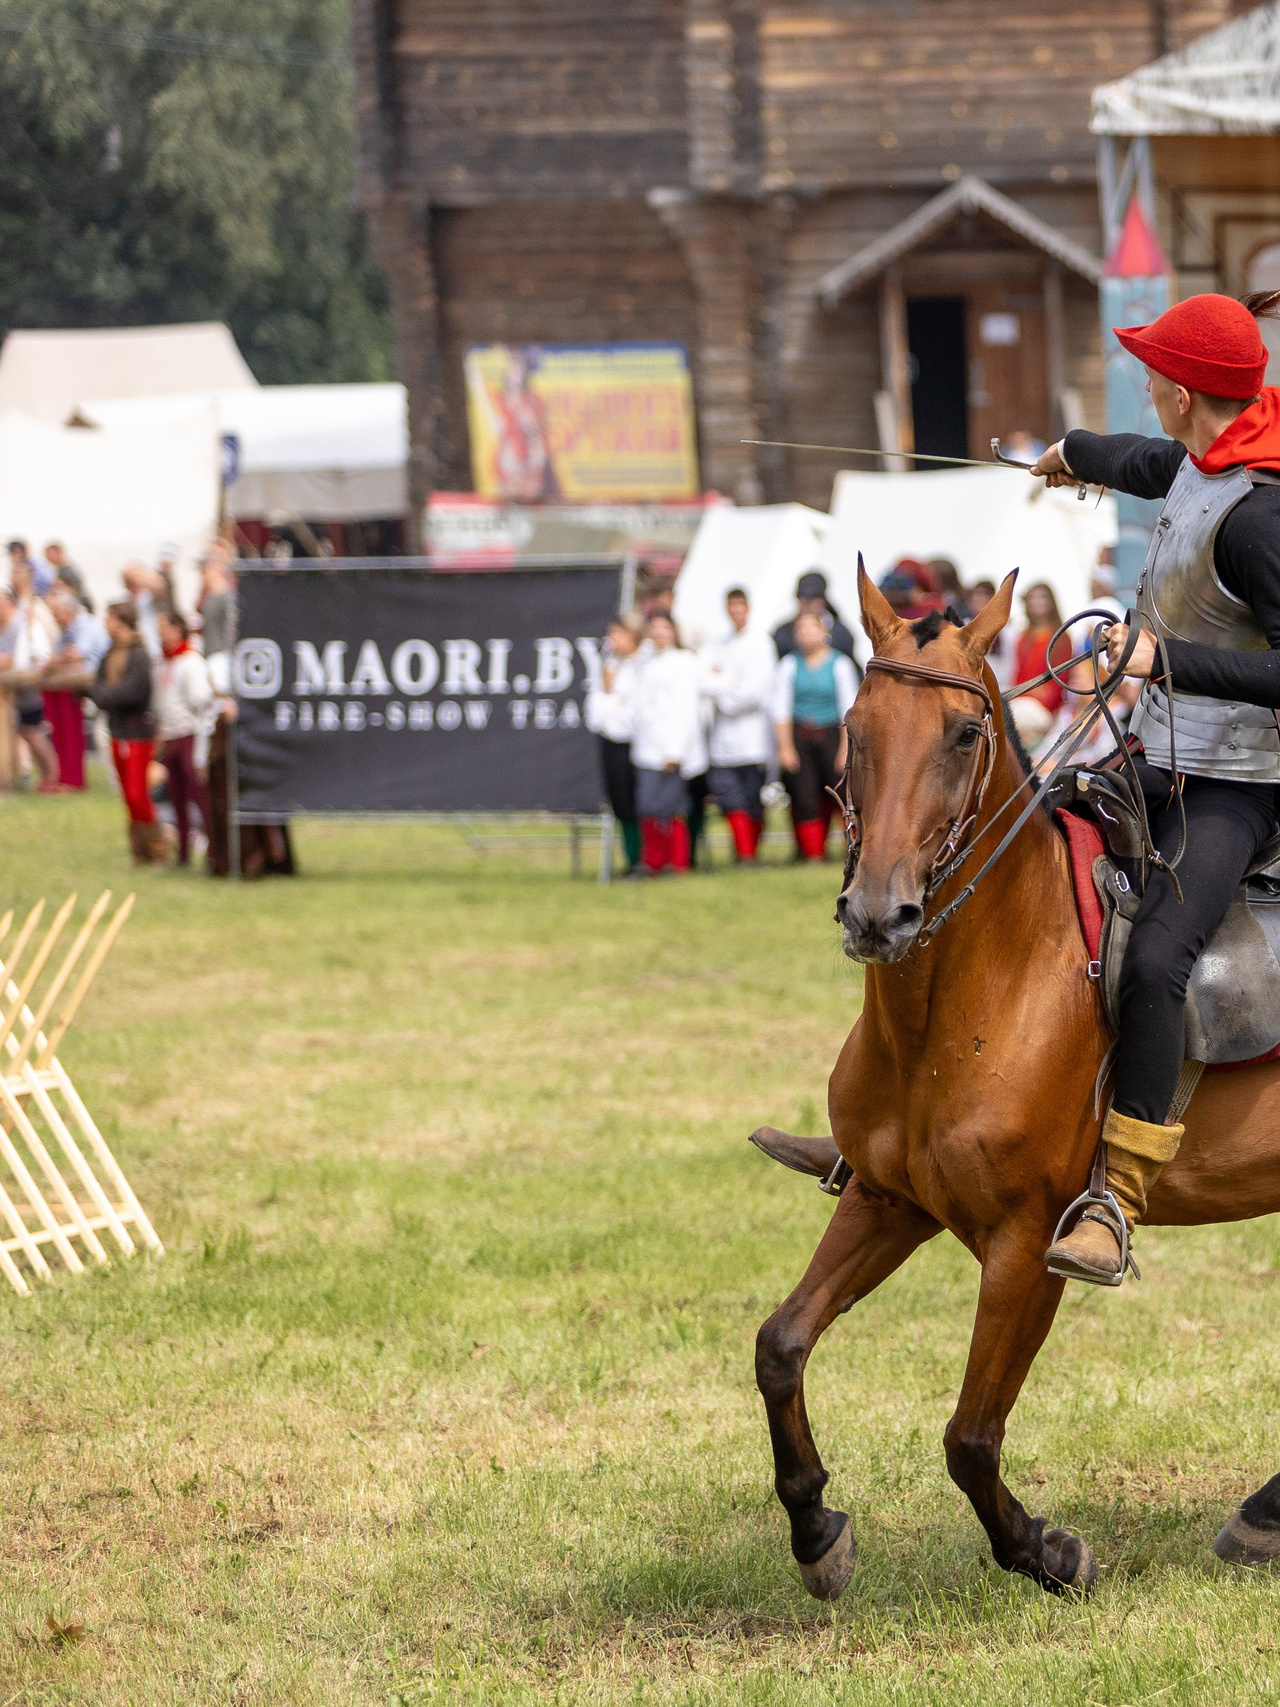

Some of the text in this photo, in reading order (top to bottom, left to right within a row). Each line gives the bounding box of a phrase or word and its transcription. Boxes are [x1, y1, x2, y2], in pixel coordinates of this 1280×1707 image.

[292, 637, 605, 696] MAORI.BY
[274, 698, 583, 731] FIRE-SHOW TEA
